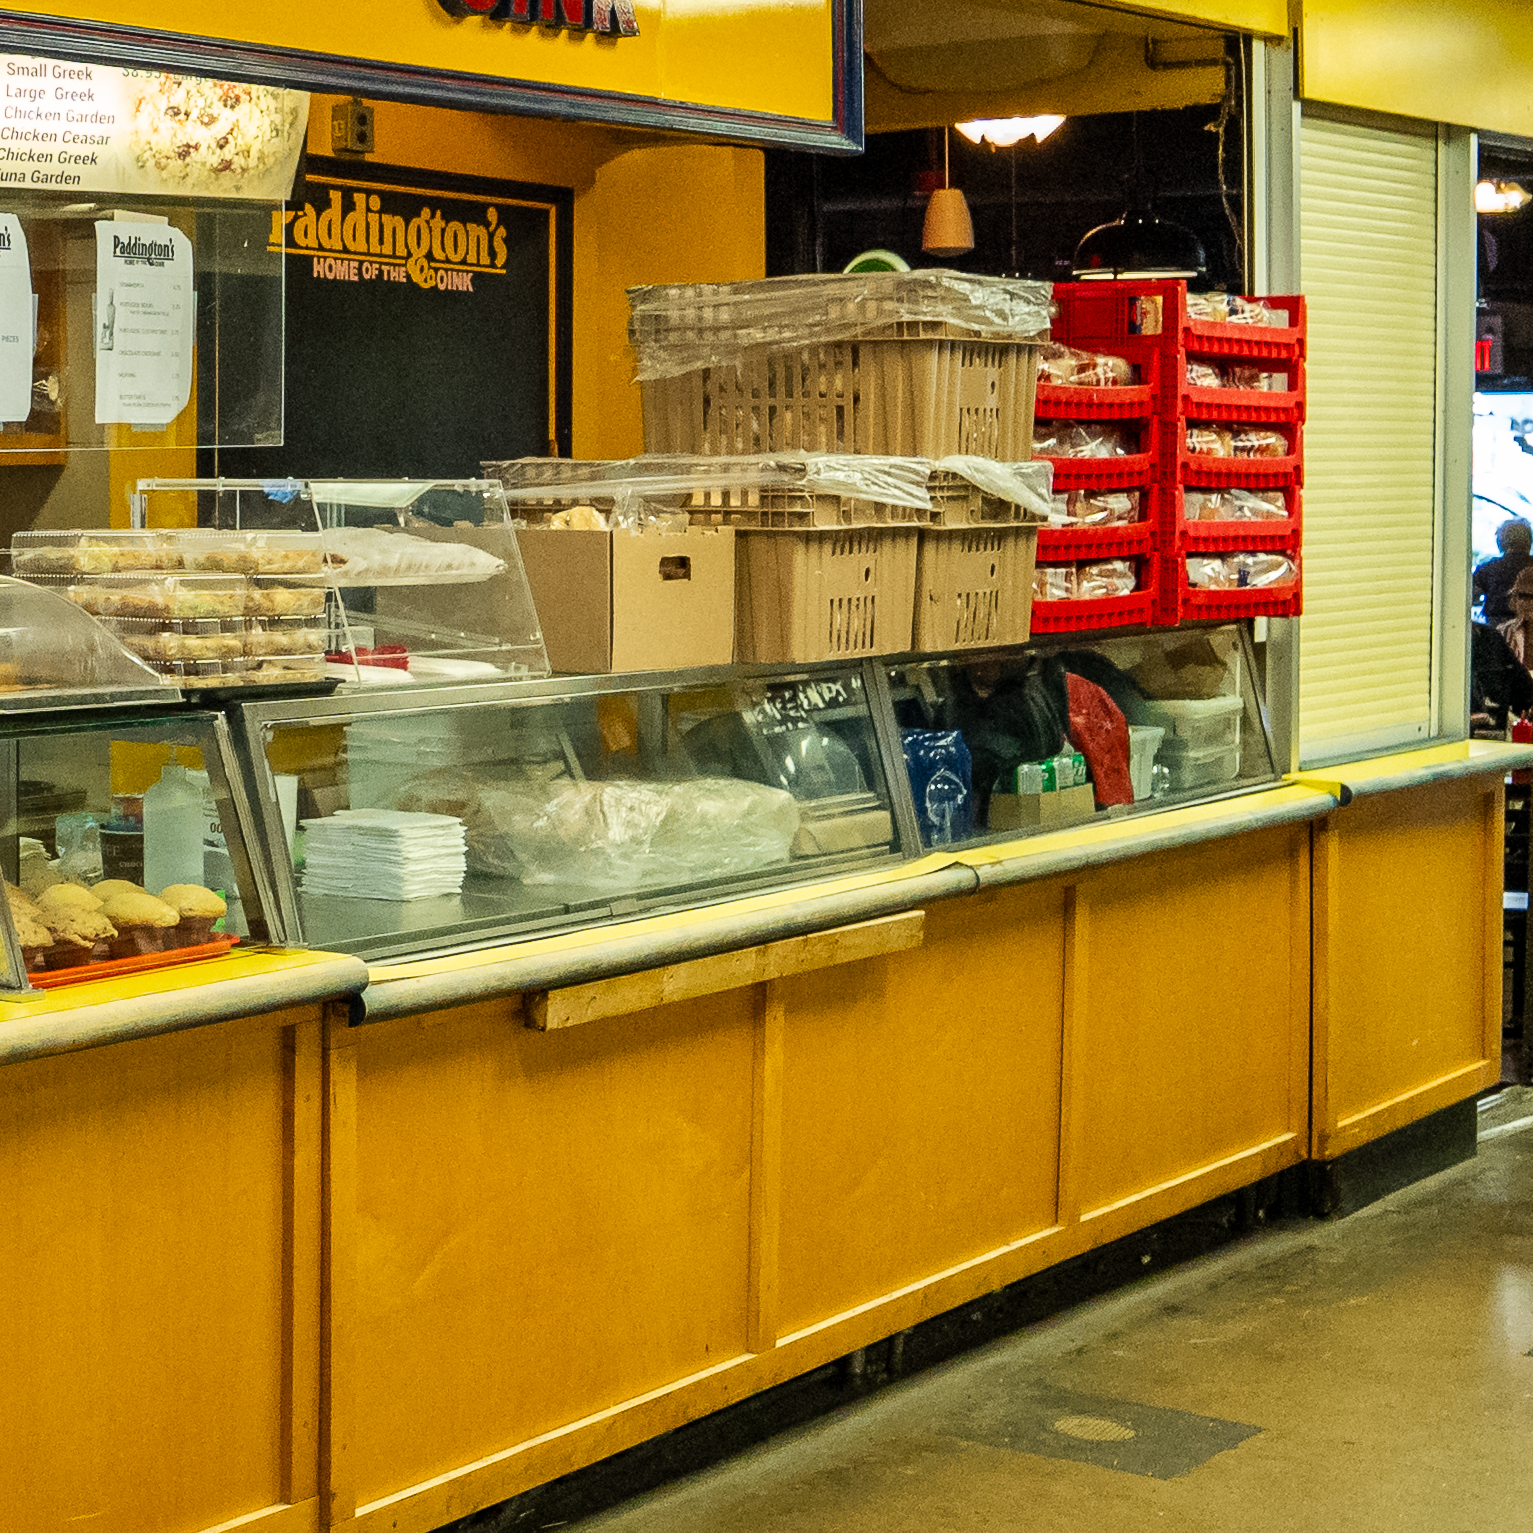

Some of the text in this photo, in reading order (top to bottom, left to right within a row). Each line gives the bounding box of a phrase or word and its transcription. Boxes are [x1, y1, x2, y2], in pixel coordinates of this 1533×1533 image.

[7, 62, 47, 78] Small
[52, 65, 93, 81] Greek
[6, 84, 46, 102] Large
[55, 86, 95, 102] Greek
[4, 106, 61, 122] Chicken
[66, 109, 115, 125] Garden
[1, 126, 57, 143] Chicken
[62, 130, 111, 146] Ceasar
[58, 150, 99, 166] Greek
[31, 170, 81, 186] Garden
[113, 234, 175, 267] Paddington's
[313, 257, 474, 292] HOME OF THE OINK
[1, 335, 20, 343] PIECES
